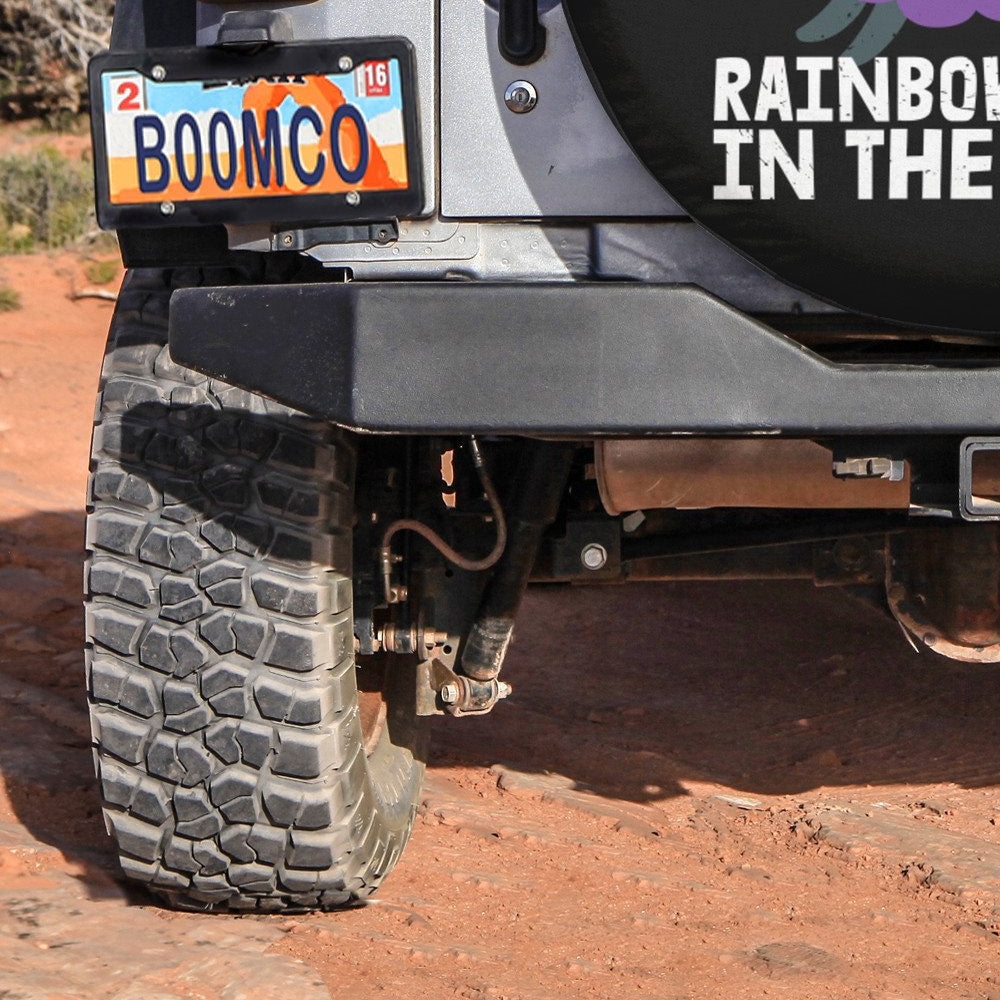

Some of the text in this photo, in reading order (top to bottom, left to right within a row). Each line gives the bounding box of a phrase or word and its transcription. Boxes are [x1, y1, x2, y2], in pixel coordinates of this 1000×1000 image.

[117, 82, 140, 110] 2
[365, 63, 387, 87] 16
[134, 104, 369, 193] BOOMCO
[713, 128, 815, 200] IN
[845, 128, 993, 200] THE
